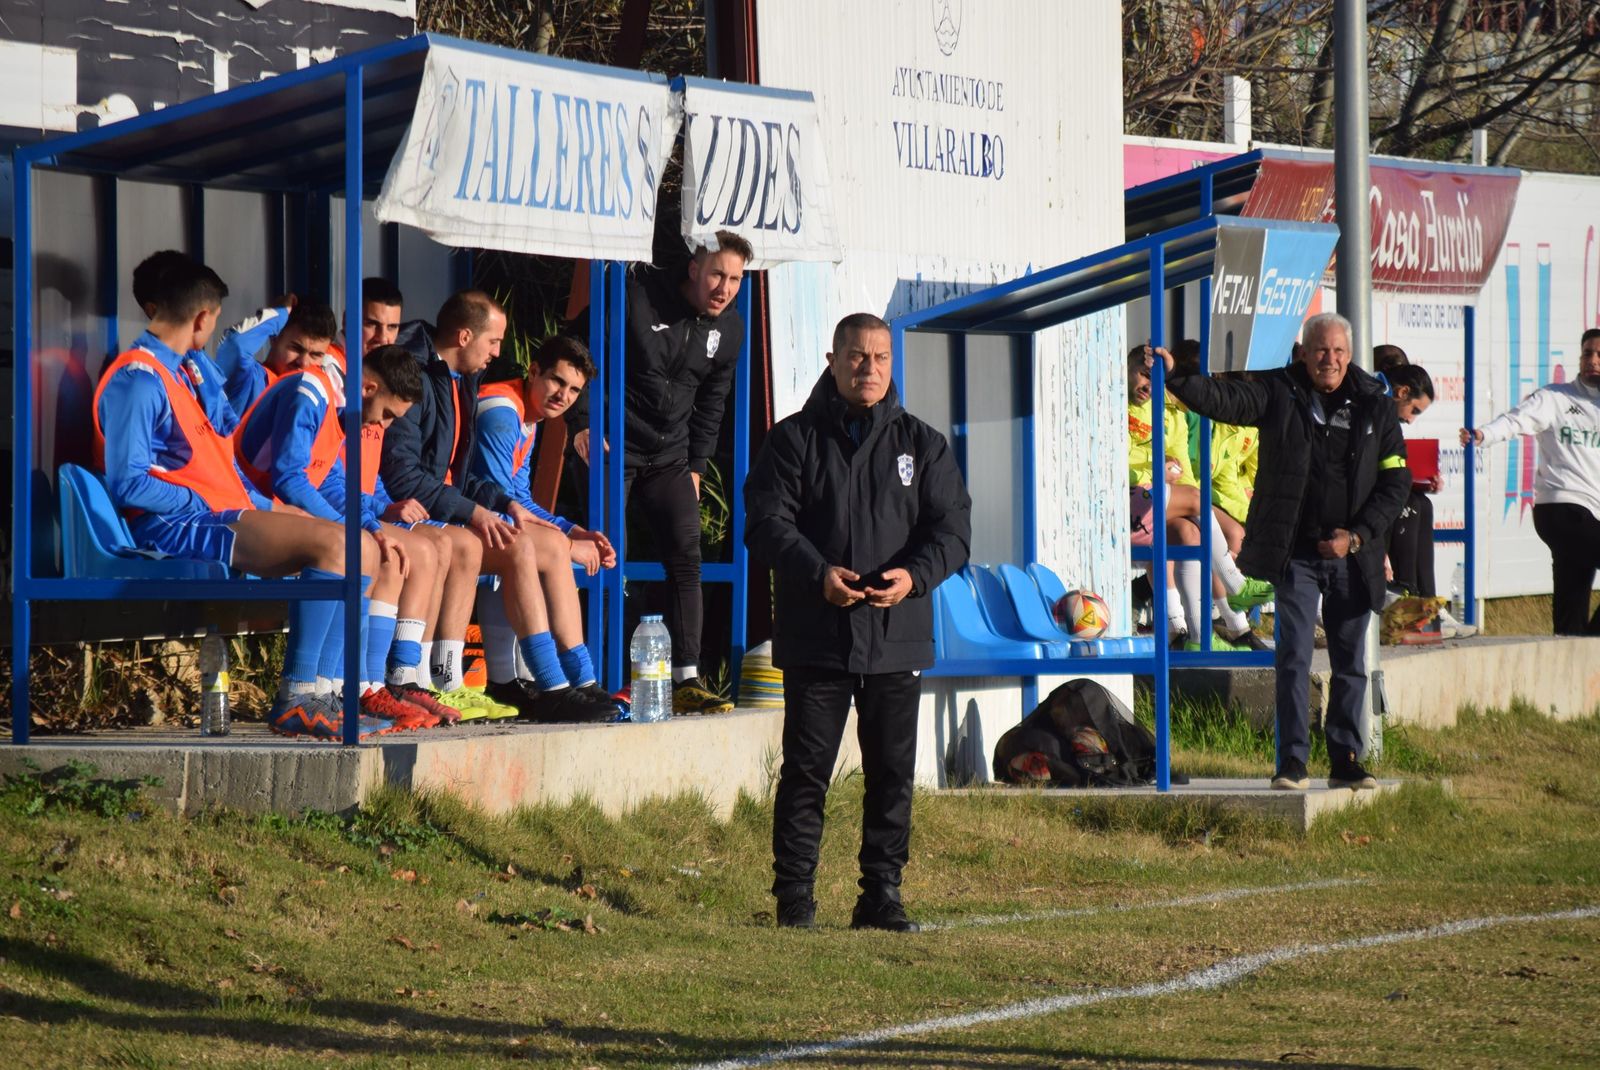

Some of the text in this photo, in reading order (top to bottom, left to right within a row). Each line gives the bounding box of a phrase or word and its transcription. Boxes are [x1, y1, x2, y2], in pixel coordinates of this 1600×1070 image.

[892, 66, 1004, 112] AYUNTAMIENTO DE
[453, 78, 634, 221] TALLERES
[892, 120, 1005, 182] VILLARALBO
[1420, 189, 1483, 275] Aurelia
